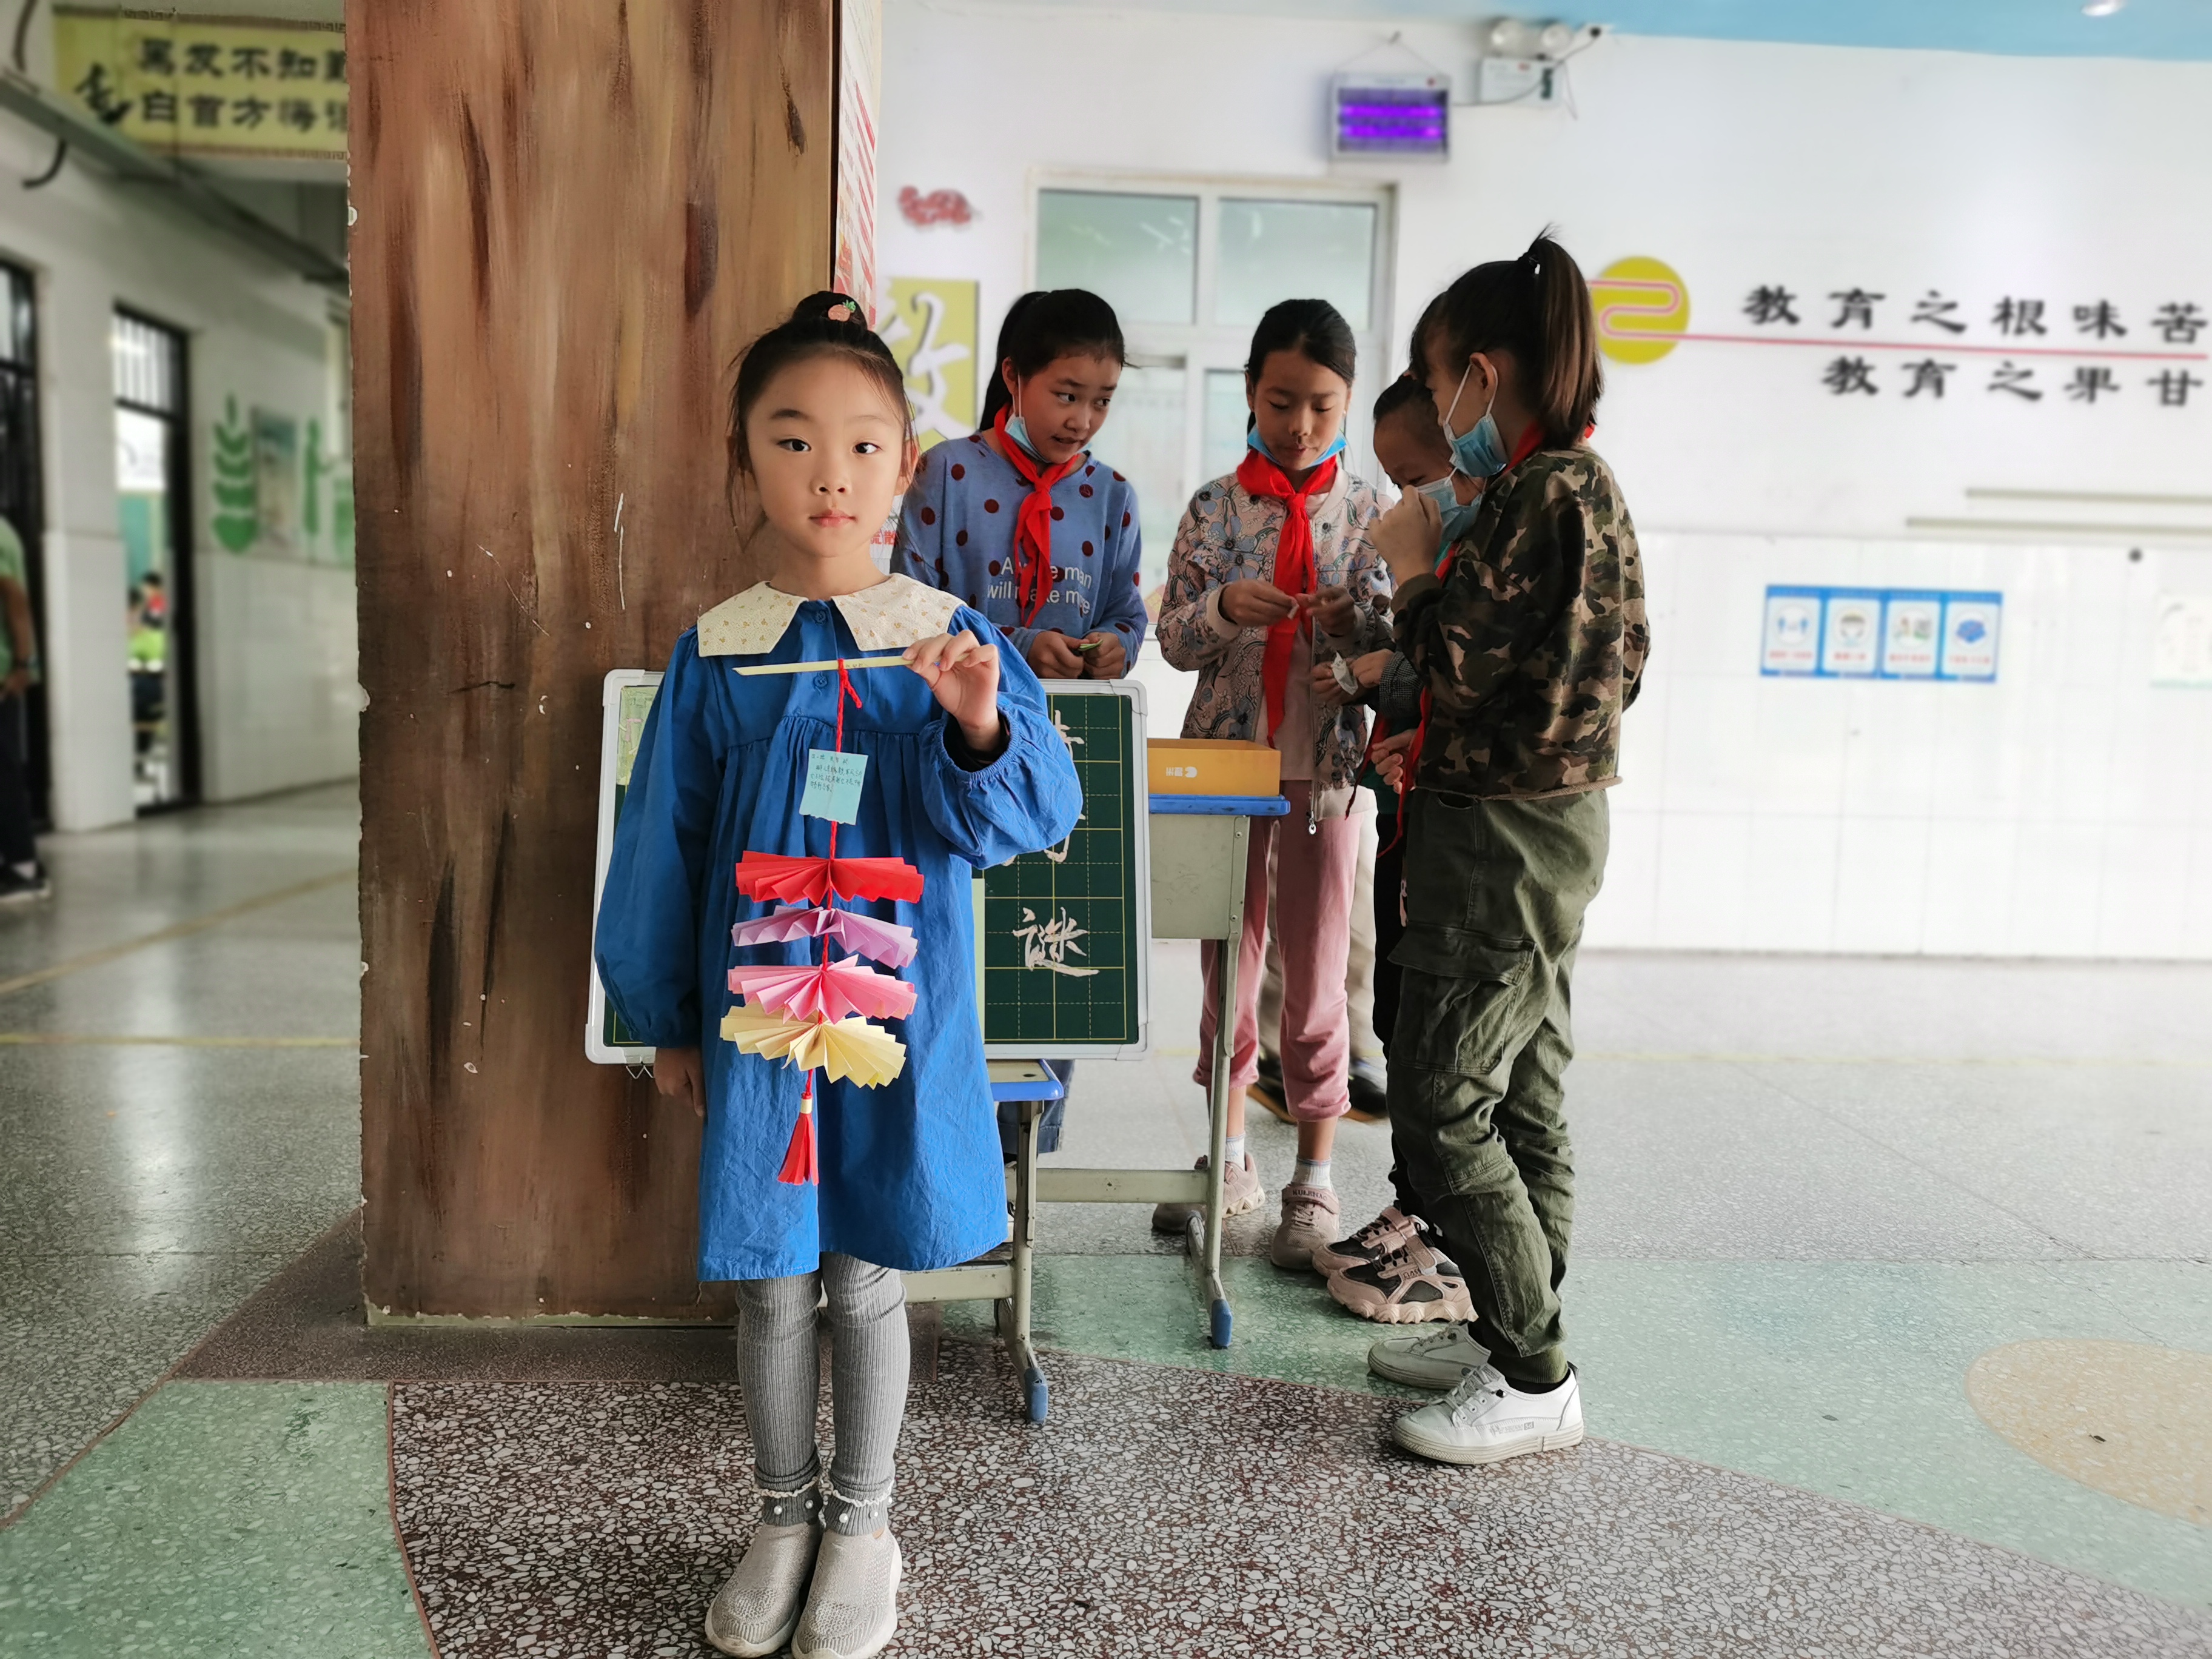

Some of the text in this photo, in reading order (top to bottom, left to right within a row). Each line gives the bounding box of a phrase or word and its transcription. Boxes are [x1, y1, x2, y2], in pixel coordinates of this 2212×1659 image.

[1742, 285, 2208, 344] 教育之根味苦
[1822, 356, 2204, 406] 教育之果甘
[1001, 556, 1014, 575] A
[987, 580, 1011, 600] will
[1014, 585, 1060, 603] ae
